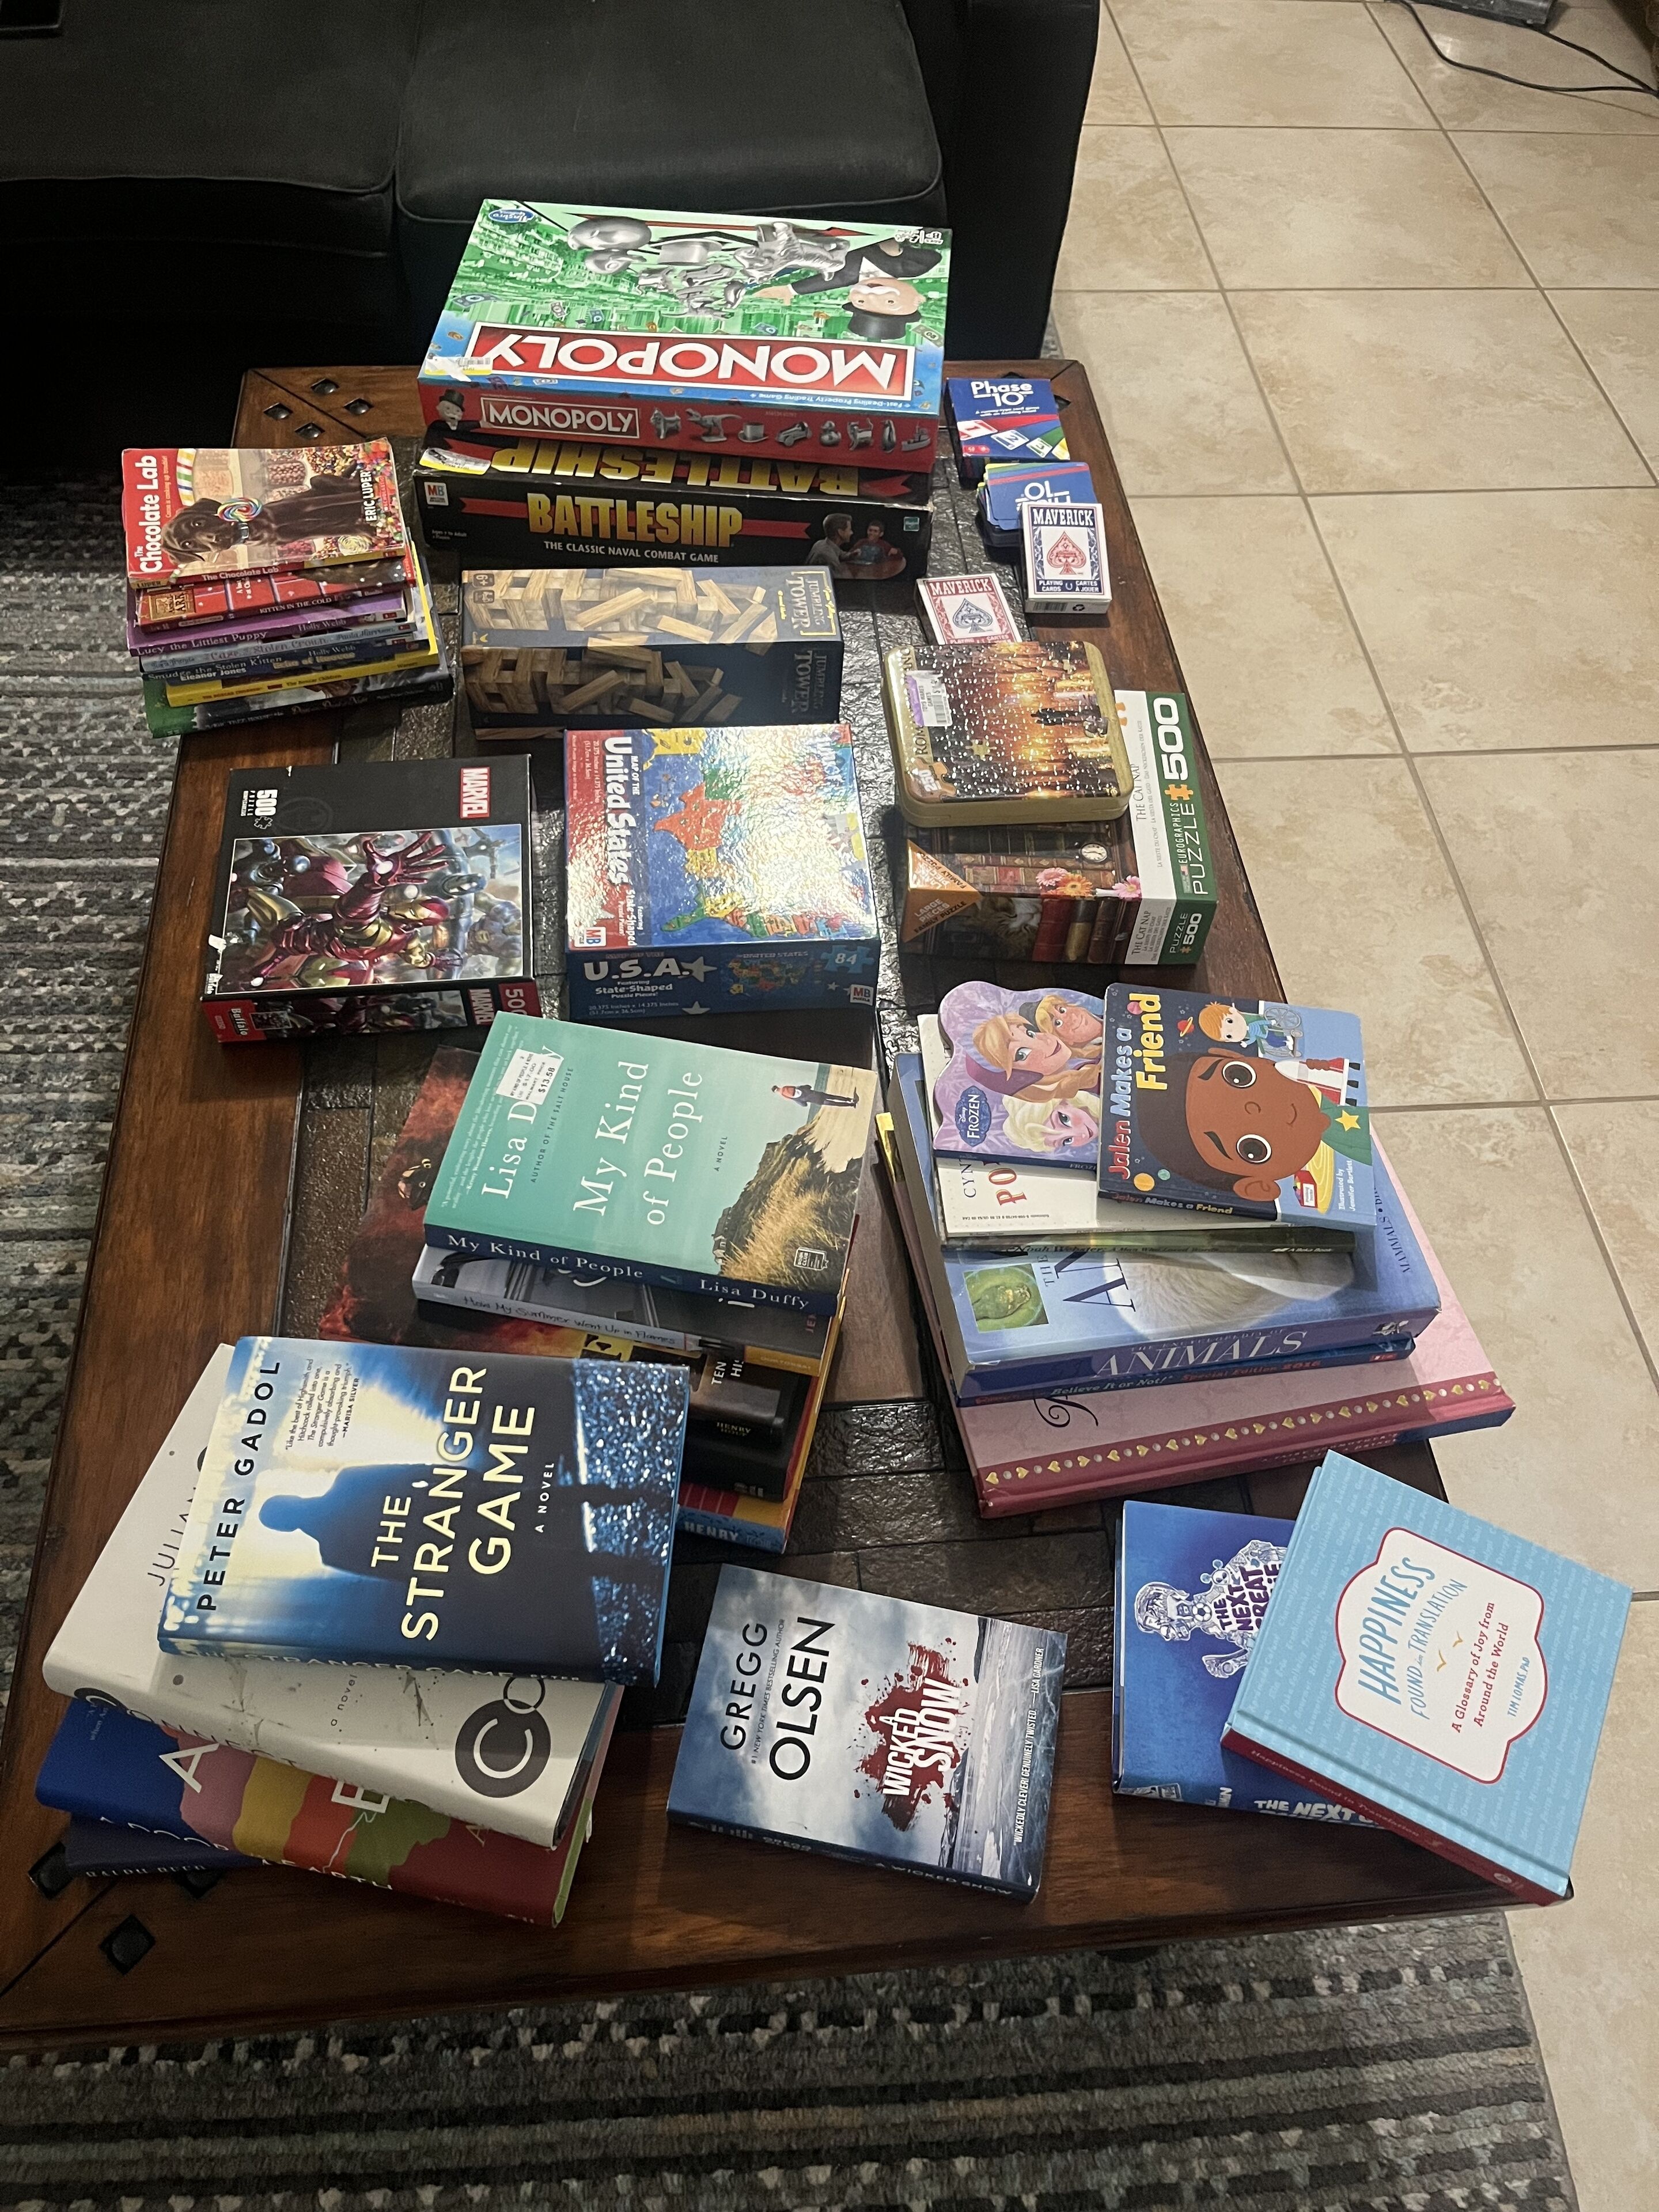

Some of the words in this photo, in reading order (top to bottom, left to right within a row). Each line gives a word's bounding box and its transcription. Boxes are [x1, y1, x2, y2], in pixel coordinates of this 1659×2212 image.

[486, 334, 896, 389] MONOPOLY
[816, 396, 852, 404] Property
[971, 381, 1032, 395] Phase
[992, 392, 1024, 407] 10
[488, 404, 633, 433] MONOPOLY
[135, 455, 159, 490] Lab
[360, 471, 374, 499] LUPER
[364, 500, 377, 521] ERIC
[527, 493, 743, 547] BATTLESHIP
[1033, 508, 1094, 527] MAVERICK
[139, 495, 163, 573] Chocolate
[134, 546, 143, 558] The
[544, 541, 563, 550] THE
[566, 543, 605, 554] CLASSIC
[608, 547, 641, 557] NAVAL
[645, 550, 686, 560] COMBAT
[690, 554, 718, 563] GAME
[202, 573, 218, 581] The
[219, 568, 261, 579] Chocolate
[262, 566, 279, 574] Lab
[929, 578, 992, 596] MAVERICK
[260, 605, 285, 614] KITTEN
[312, 597, 332, 605] COLD
[786, 577, 810, 629] TOWER
[137, 645, 165, 656] Lucy
[170, 642, 187, 650] the
[191, 637, 229, 648] Littlest
[232, 631, 267, 642] Puppy
[221, 667, 247, 676] Jones
[791, 650, 812, 713] TOWER
[1153, 698, 1188, 781] 500
[605, 737, 632, 808] United
[631, 755, 639, 771] MAP
[632, 772, 639, 781] OF
[255, 789, 278, 816] 500
[462, 768, 488, 817] MARVEL
[1136, 804, 1147, 821] THE
[1171, 802, 1188, 863] EUROGRAPHICS
[607, 813, 637, 885] States
[1182, 803, 1208, 895] PUZZLE
[625, 889, 637, 946] State-Shaped
[914, 899, 943, 916] LARGE
[919, 903, 950, 922] PIECES
[940, 901, 967, 918] PUZZLE
[1141, 910, 1152, 925] NAP
[586, 930, 601, 945] MB
[1136, 926, 1146, 940] CAT
[1170, 913, 1188, 953] PUZZLE
[1183, 913, 1202, 945] 500
[835, 953, 857, 964] 84
[1131, 941, 1142, 955] THE
[584, 958, 690, 980] U.S.A.
[596, 983, 673, 994] State-Shaped
[853, 987, 871, 997] MB
[469, 989, 493, 1024] MARVEL
[231, 1008, 249, 1036] Buffalo
[1115, 1028, 1132, 1041] a
[1130, 994, 1167, 1090] Friend
[537, 1067, 555, 1094] $13.58
[1110, 1046, 1132, 1117] Makes
[595, 1061, 649, 1144] Kind
[967, 1094, 980, 1139] FROZEN
[531, 1149, 546, 1183] AUTHOR
[540, 1135, 550, 1145] OF
[547, 1117, 557, 1131] THE
[554, 1096, 564, 1113] SALT
[560, 1068, 573, 1093] HOUSE
[644, 1072, 703, 1183] People
[716, 1137, 728, 1163] NOVEL
[1108, 1120, 1131, 1180] Jalen
[481, 1138, 528, 1199] Lisa
[573, 1157, 627, 1217] My
[1336, 1177, 1345, 1210] Illustrated
[1347, 1185, 1355, 1211] Jennifer
[643, 1191, 669, 1225] of
[1145, 1196, 1184, 1209] Makes
[1196, 1203, 1233, 1215] Friend
[448, 1234, 480, 1252] My
[491, 1242, 540, 1260] Kind
[550, 1256, 568, 1265] of
[576, 1257, 643, 1278] People
[1380, 1216, 1411, 1273] MAMMALS
[1037, 1255, 1054, 1287] THE
[700, 1279, 741, 1296] Lisa
[752, 1288, 809, 1310] Duffy
[495, 1302, 512, 1314] My
[516, 1306, 569, 1324] Summer
[575, 1319, 601, 1332] Went
[605, 1321, 622, 1334] Up
[635, 1330, 676, 1345] Flames
[1095, 1331, 1308, 1378] ANIMALS
[309, 1381, 318, 1392] into
[711, 1361, 727, 1385] TEN
[305, 1393, 315, 1411] rolled
[317, 1382, 327, 1401] Game
[349, 1378, 359, 1402] SILVER
[1051, 1385, 1100, 1396] Believe
[291, 1411, 300, 1423] best
[310, 1402, 323, 1429] Stranger
[318, 1408, 332, 1447] compulsively
[325, 1377, 340, 1407] absorbing
[289, 1425, 297, 1434] the
[308, 1430, 316, 1441] The
[196, 1498, 245, 1611] PETER
[234, 1362, 281, 1476] GADOL
[468, 1406, 535, 1574] GAME
[537, 1462, 555, 1514] NOVEL
[401, 1366, 487, 1641] STRANGER
[371, 1495, 411, 1568] THE
[535, 1524, 544, 1532] A
[684, 1521, 739, 1541] HENRY
[1214, 1598, 1232, 1631] THE
[1226, 1585, 1253, 1631] NEXT
[1407, 1579, 1468, 1653] TRANSLATION
[1479, 1603, 1495, 1629] from
[775, 1619, 785, 1647] AUTHOR
[1358, 1557, 1435, 1705] HAPPINESS
[1474, 1631, 1488, 1652] Joy
[1491, 1622, 1509, 1657] World
[764, 1649, 779, 1691] BESTSELLING
[1471, 1652, 1481, 1666] of
[1486, 1661, 1498, 1680] the
[337, 1674, 357, 1711] novel
[721, 1623, 767, 1750] GREGG
[769, 1617, 835, 1781] OLSEN
[1407, 1666, 1430, 1720] FOUND
[1455, 1668, 1479, 1719] Glossary
[761, 1692, 771, 1712] TIMES
[1021, 1740, 1034, 1777] GENUINELY
[1033, 1648, 1044, 1678] GARDNER
[1474, 1681, 1494, 1728] Around
[1508, 1700, 1520, 1717] TIM
[757, 1713, 766, 1733] YORK
[915, 1678, 961, 1772] SNOW
[1452, 1722, 1461, 1733] A
[753, 1734, 762, 1753] NEW
[882, 1707, 921, 1796] WICKED
[1254, 1800, 1289, 1812] THE
[1293, 1801, 1355, 1821] NEXT
[892, 1865, 956, 1883] WICKED
[961, 1877, 1013, 1895] SNOW
